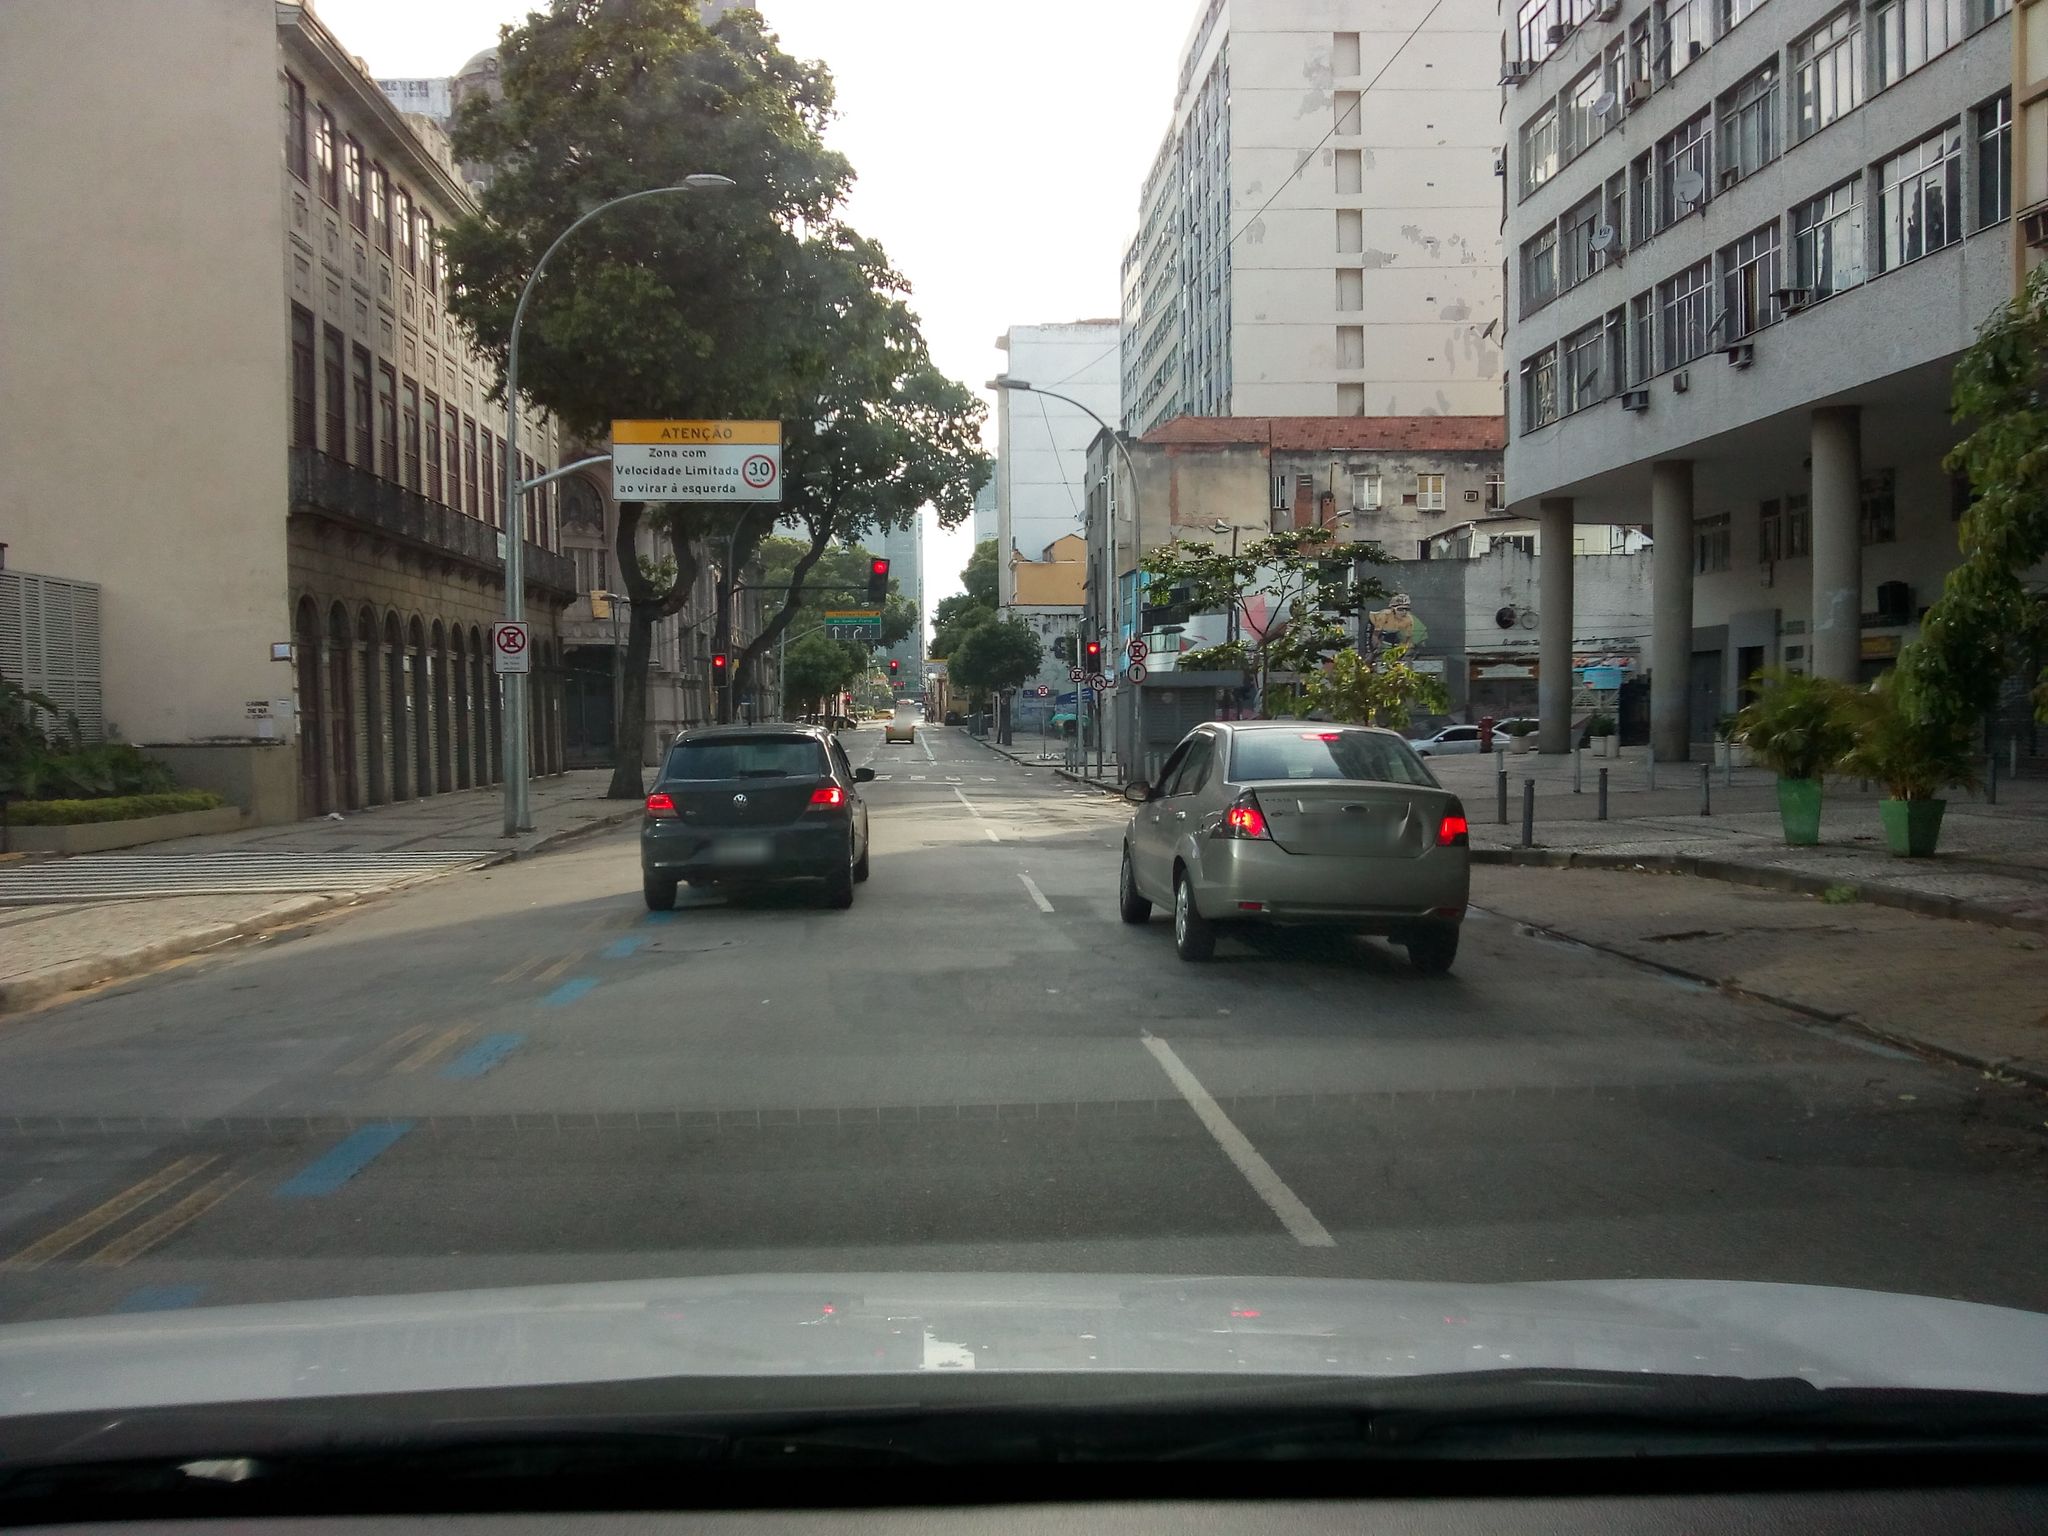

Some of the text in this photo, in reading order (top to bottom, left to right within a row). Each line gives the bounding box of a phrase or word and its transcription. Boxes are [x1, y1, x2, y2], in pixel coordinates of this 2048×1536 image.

[660, 424, 733, 441] ATENÇÃO
[648, 447, 707, 458] Zona com
[615, 465, 739, 475] Velocidade Limitada
[748, 461, 770, 476] 30
[619, 485, 634, 493] ao
[637, 483, 667, 493] virar
[682, 483, 736, 495] esquerda
